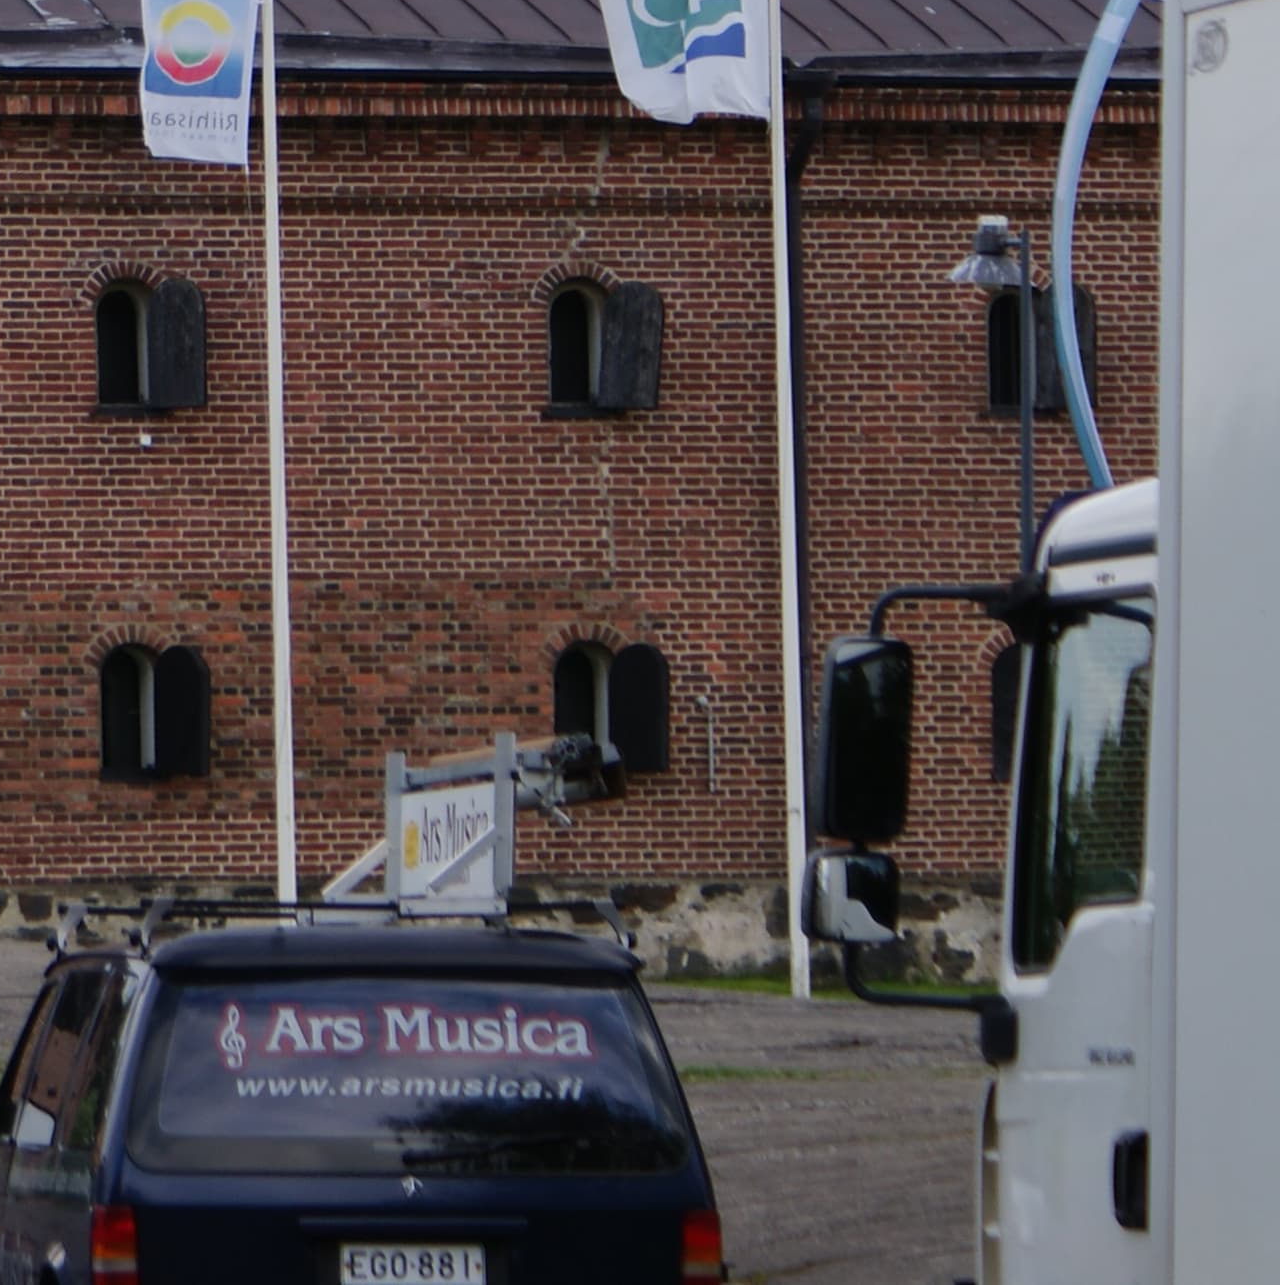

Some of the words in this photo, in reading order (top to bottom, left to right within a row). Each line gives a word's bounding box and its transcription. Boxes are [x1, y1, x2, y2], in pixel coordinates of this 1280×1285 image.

[421, 806, 441, 863] Ars
[265, 1007, 364, 1053] Ars
[383, 1006, 592, 1057] Musica
[237, 1074, 584, 1101] www.arsmusica.fi
